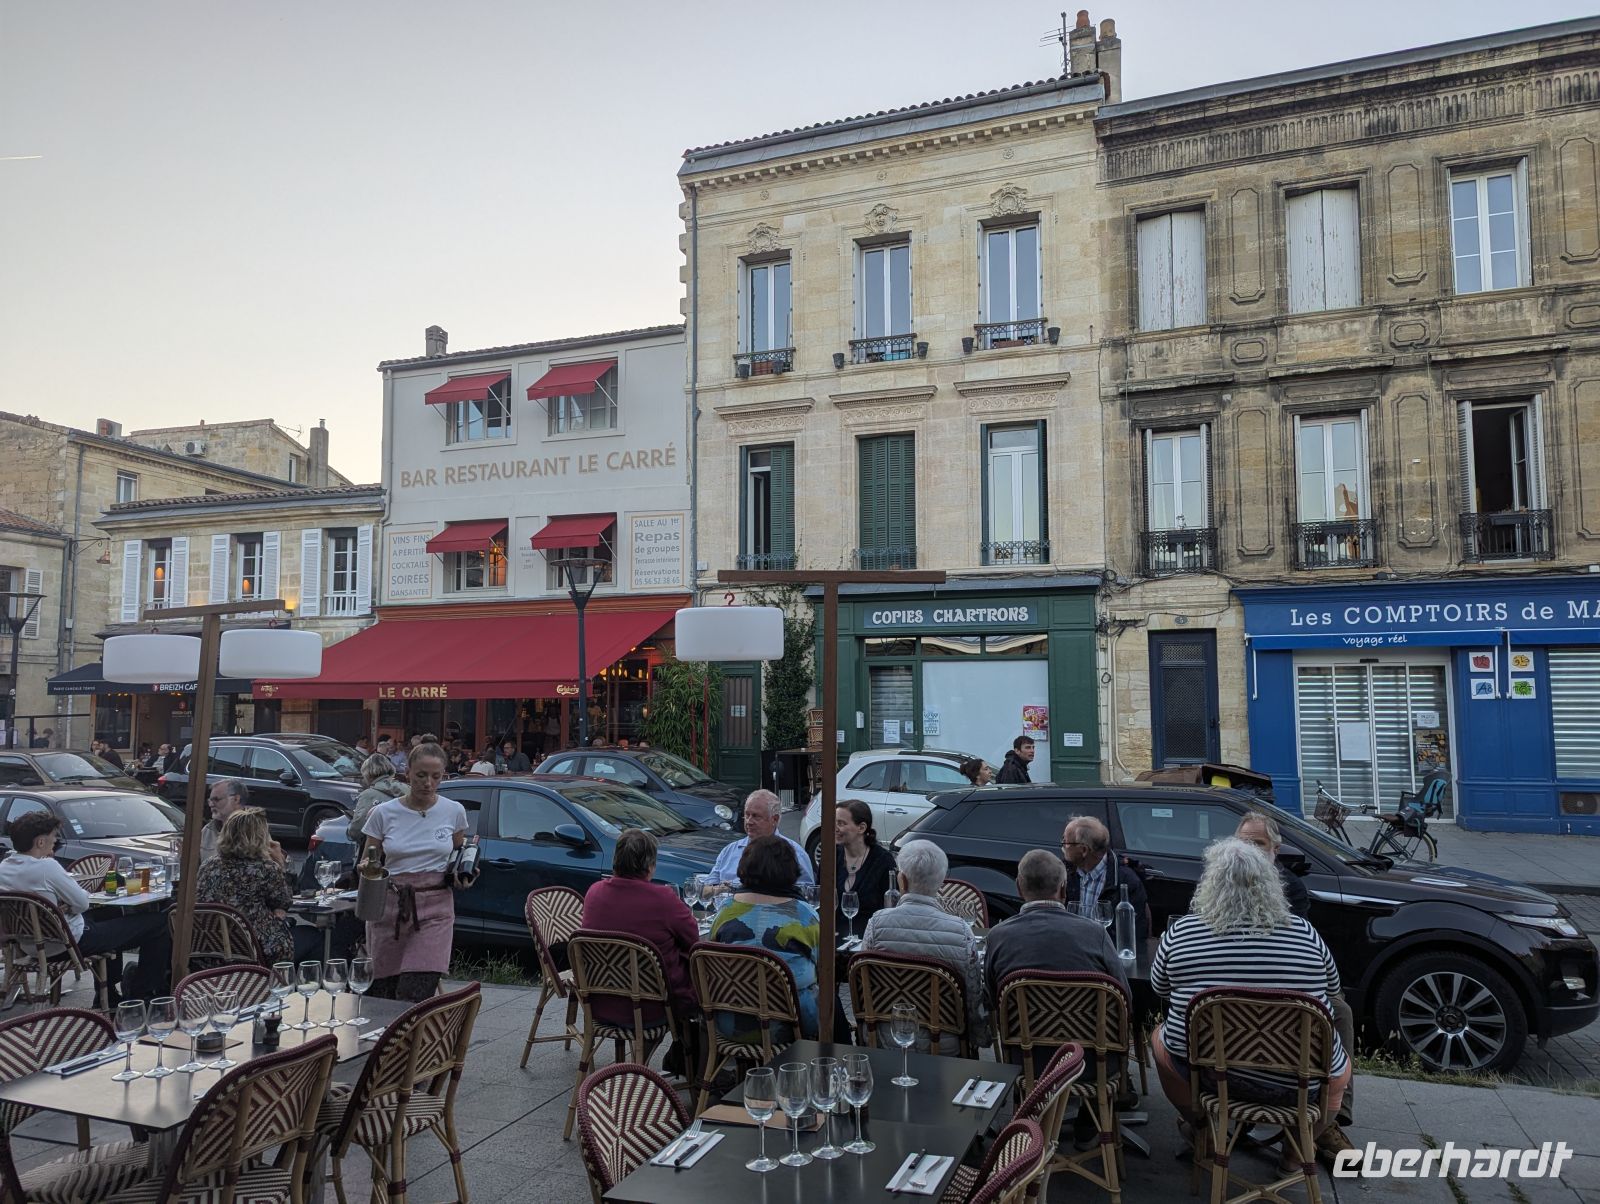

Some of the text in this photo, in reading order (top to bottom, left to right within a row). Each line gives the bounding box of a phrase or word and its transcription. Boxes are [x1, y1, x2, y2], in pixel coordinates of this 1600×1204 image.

[400, 442, 676, 488] BAR RESTAURANT LE CARRÉ
[634, 519, 655, 528] SALLE
[656, 518, 668, 527] AU
[392, 534, 430, 545] VINS FINS
[634, 532, 680, 543] Repas
[634, 545, 680, 555] de groupes
[391, 560, 430, 570] COCKTAILS
[390, 588, 430, 597] DANSANTES
[872, 606, 1029, 625] COPIES CHARTRONS
[1290, 608, 1332, 626] Les
[1344, 602, 1508, 625] COMPTOIRS
[1521, 602, 1554, 620] de
[1342, 634, 1408, 648] voyage réel
[159, 683, 198, 691] BREIZH CAF
[378, 683, 448, 698] LE CARRÉ
